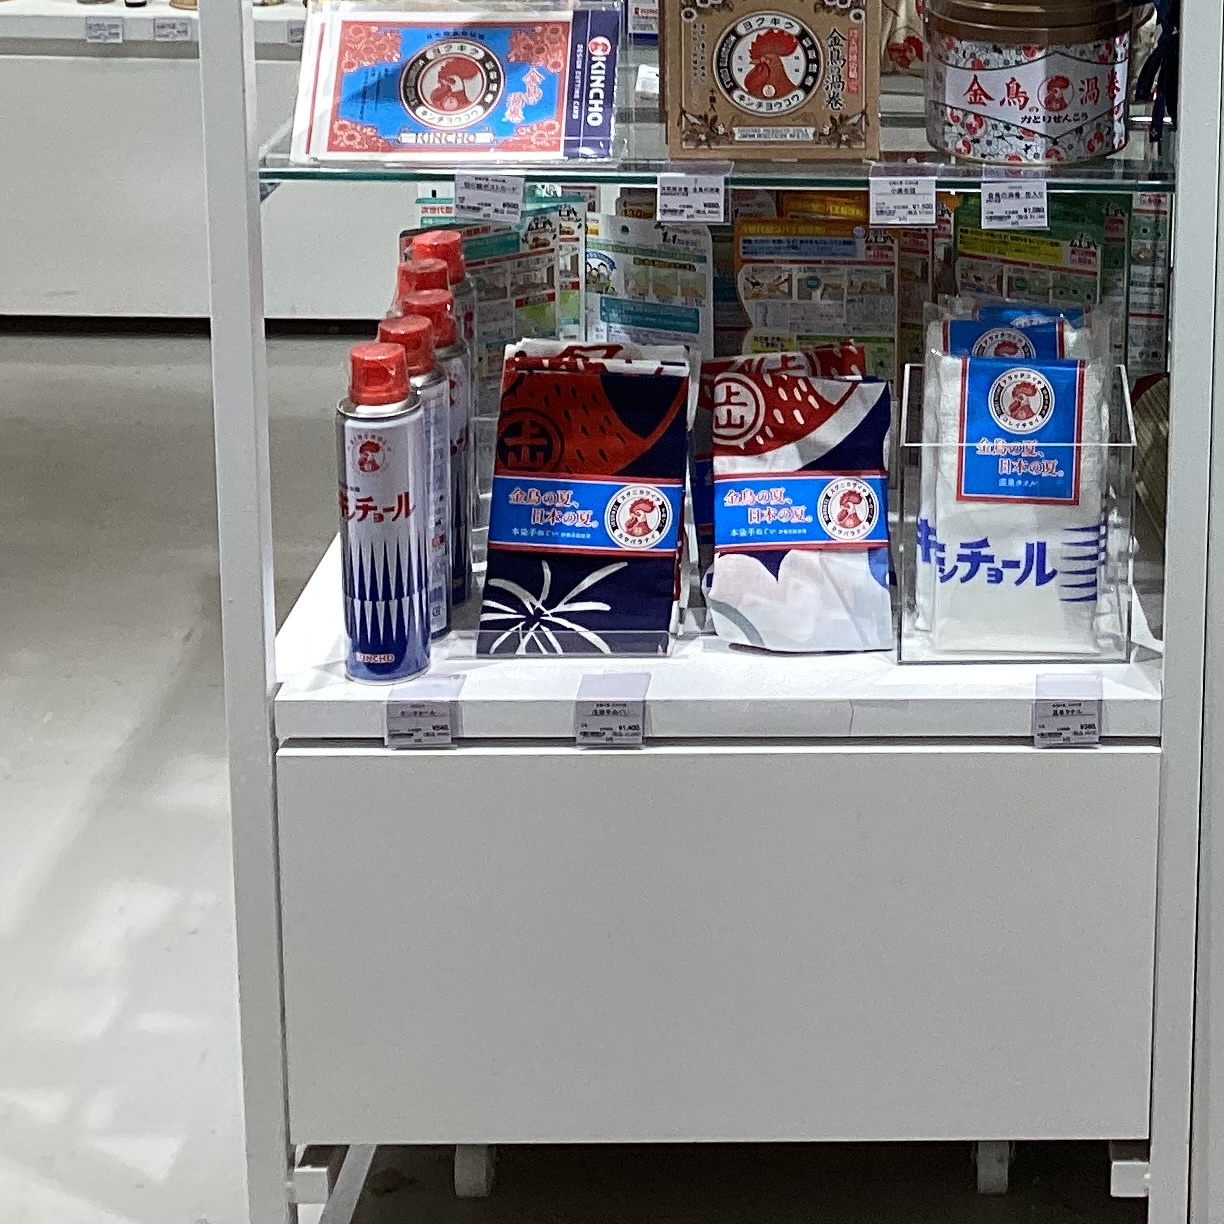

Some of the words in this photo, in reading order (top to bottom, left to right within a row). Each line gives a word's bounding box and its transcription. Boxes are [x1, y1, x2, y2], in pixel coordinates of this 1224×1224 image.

[587, 55, 607, 128] KINCHO
[915, 518, 1058, 588] キンチョール
